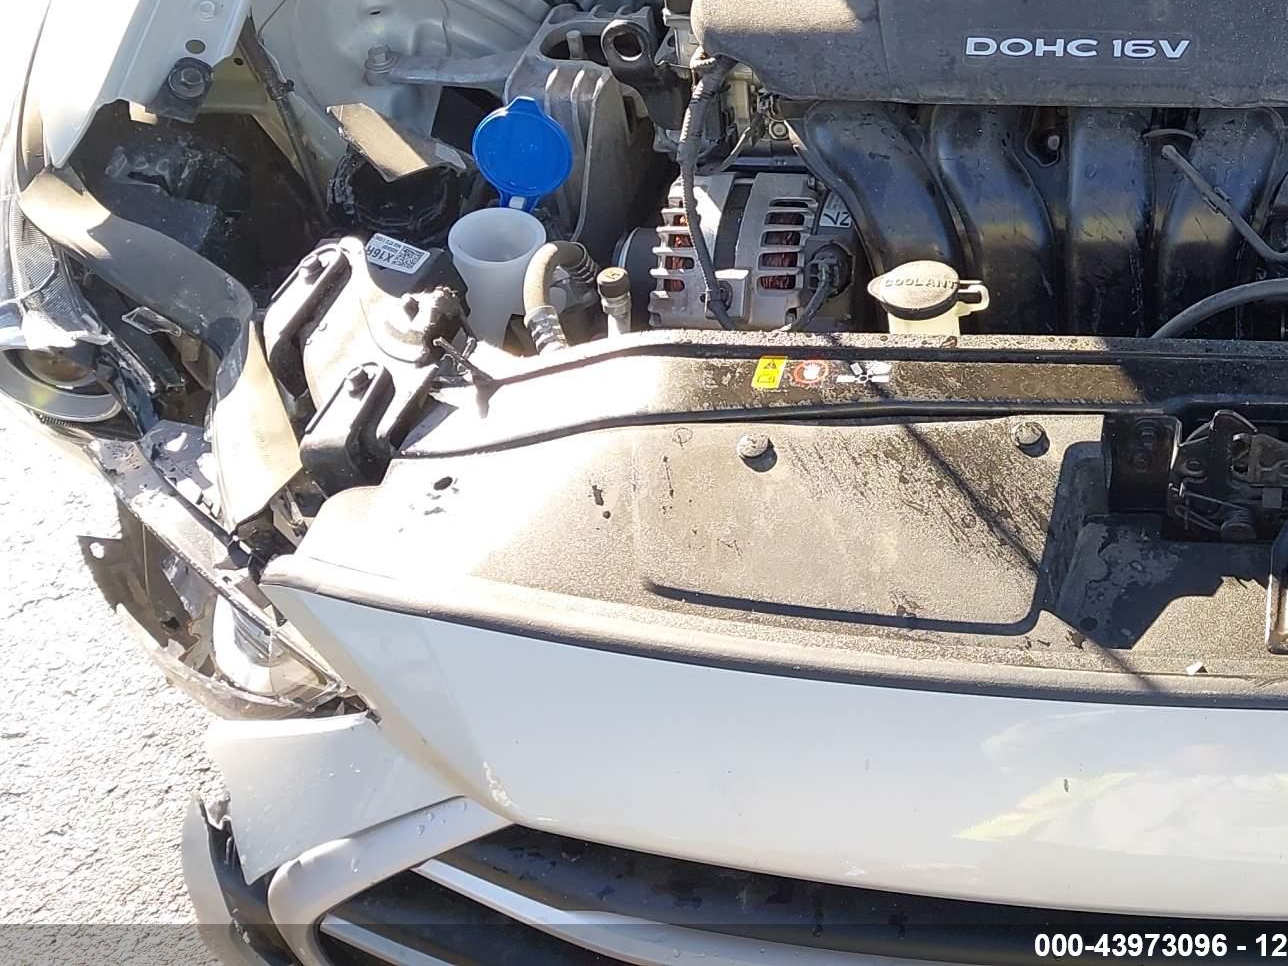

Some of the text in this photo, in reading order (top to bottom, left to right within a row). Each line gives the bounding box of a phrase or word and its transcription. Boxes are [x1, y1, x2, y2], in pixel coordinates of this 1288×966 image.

[965, 37, 1191, 59] DOHC 16V
[884, 275, 958, 290] COOLANT
